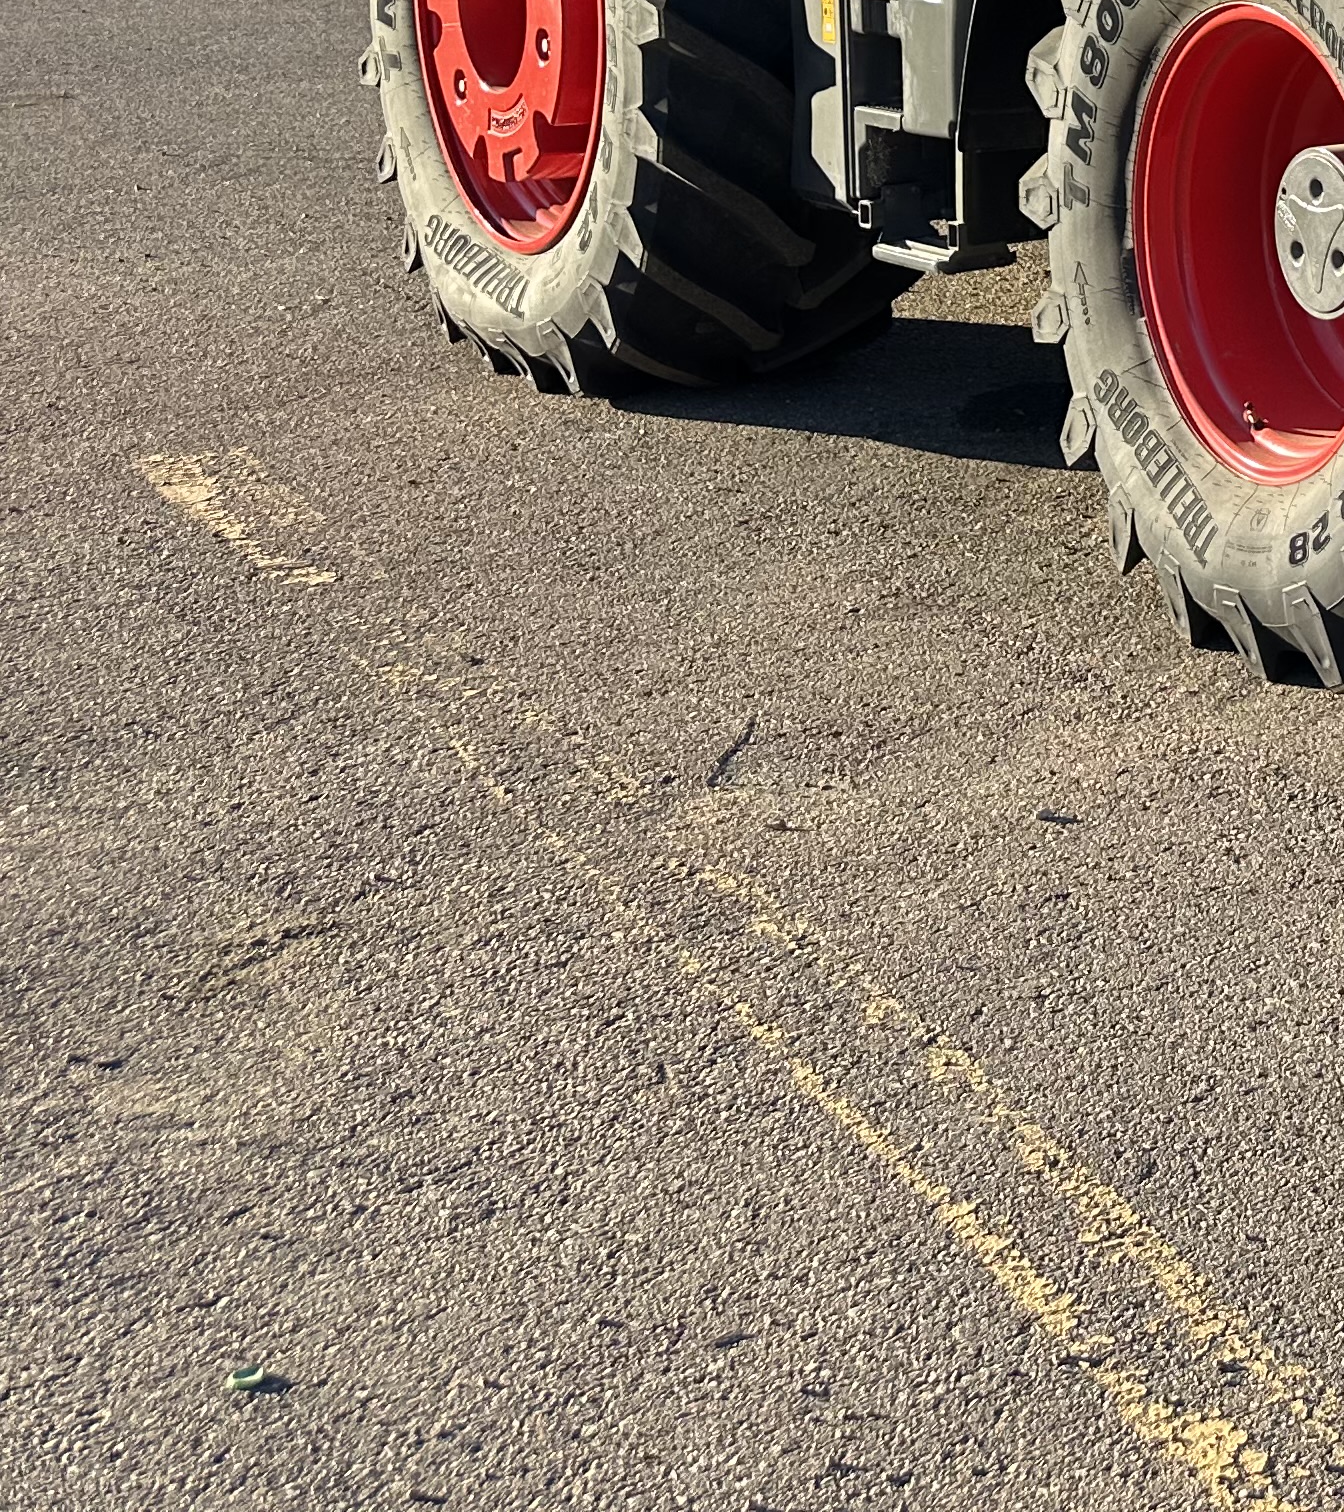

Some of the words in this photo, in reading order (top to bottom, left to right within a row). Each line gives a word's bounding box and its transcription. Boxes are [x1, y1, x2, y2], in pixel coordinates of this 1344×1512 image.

[1063, 85, 1098, 211] TM
[424, 212, 531, 321] TRELLEBORG
[1092, 368, 1220, 570] TRELLEBORG
[1288, 510, 1334, 568] 28
